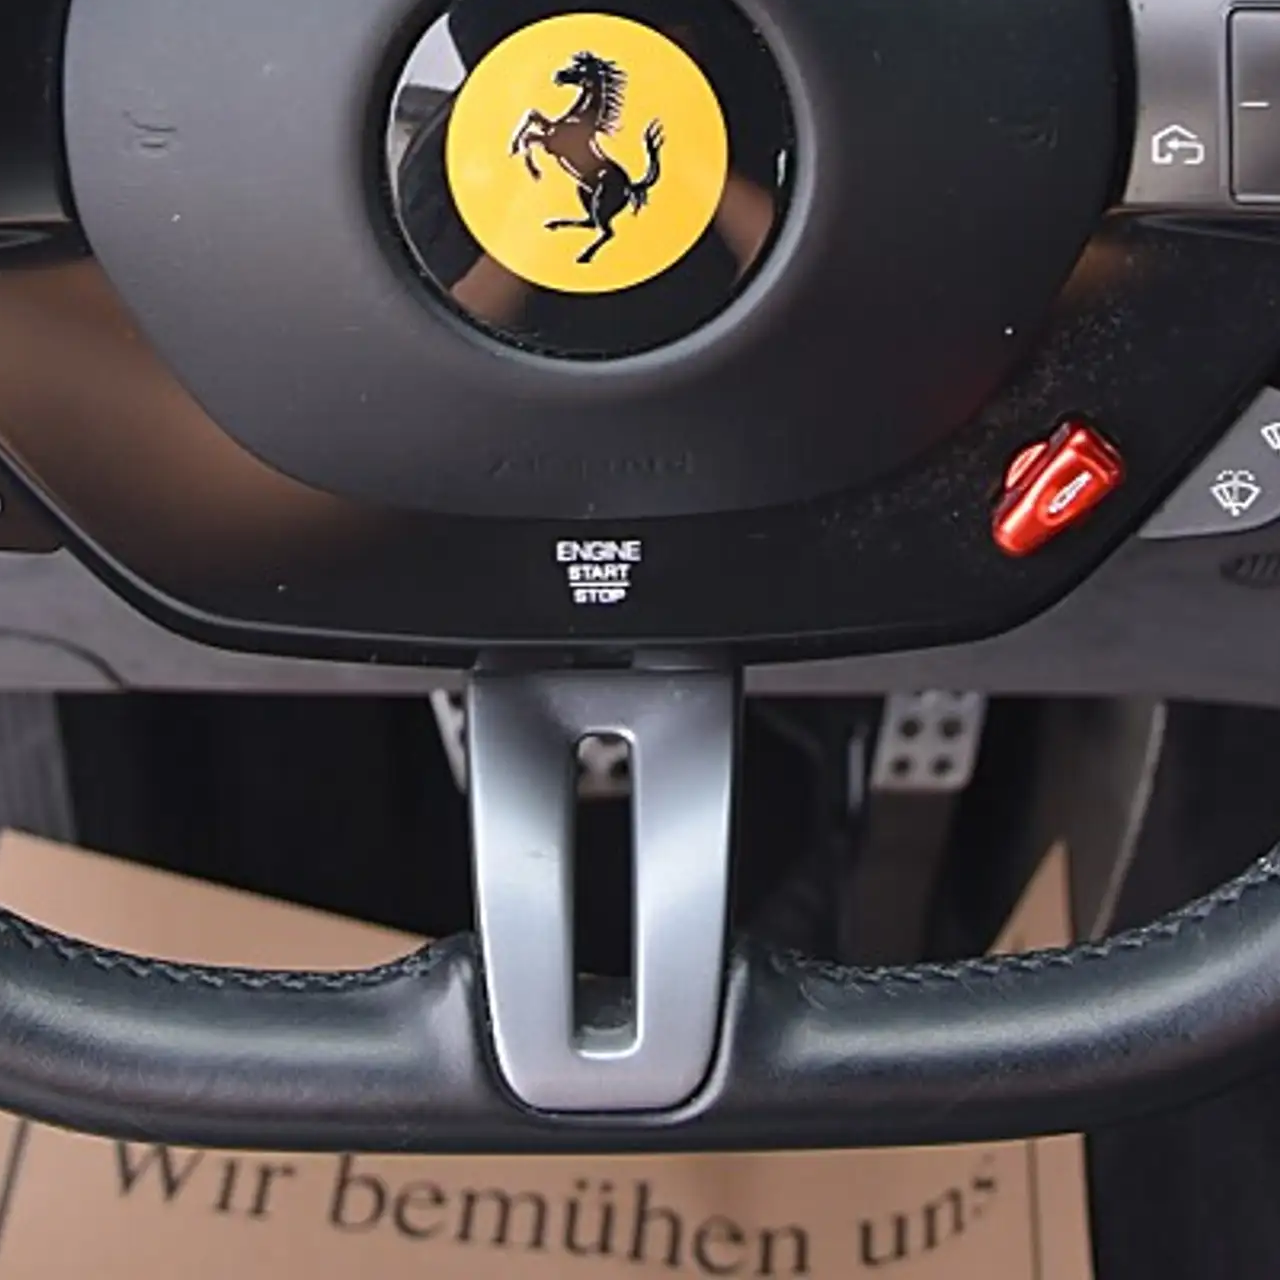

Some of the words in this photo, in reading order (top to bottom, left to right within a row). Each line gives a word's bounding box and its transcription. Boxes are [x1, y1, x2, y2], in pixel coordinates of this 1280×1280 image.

[556, 540, 641, 562] ENGINE
[567, 563, 631, 581] START
[573, 588, 626, 604] STOP
[113, 1140, 297, 1219] Wir
[328, 1153, 811, 1277] bemühen
